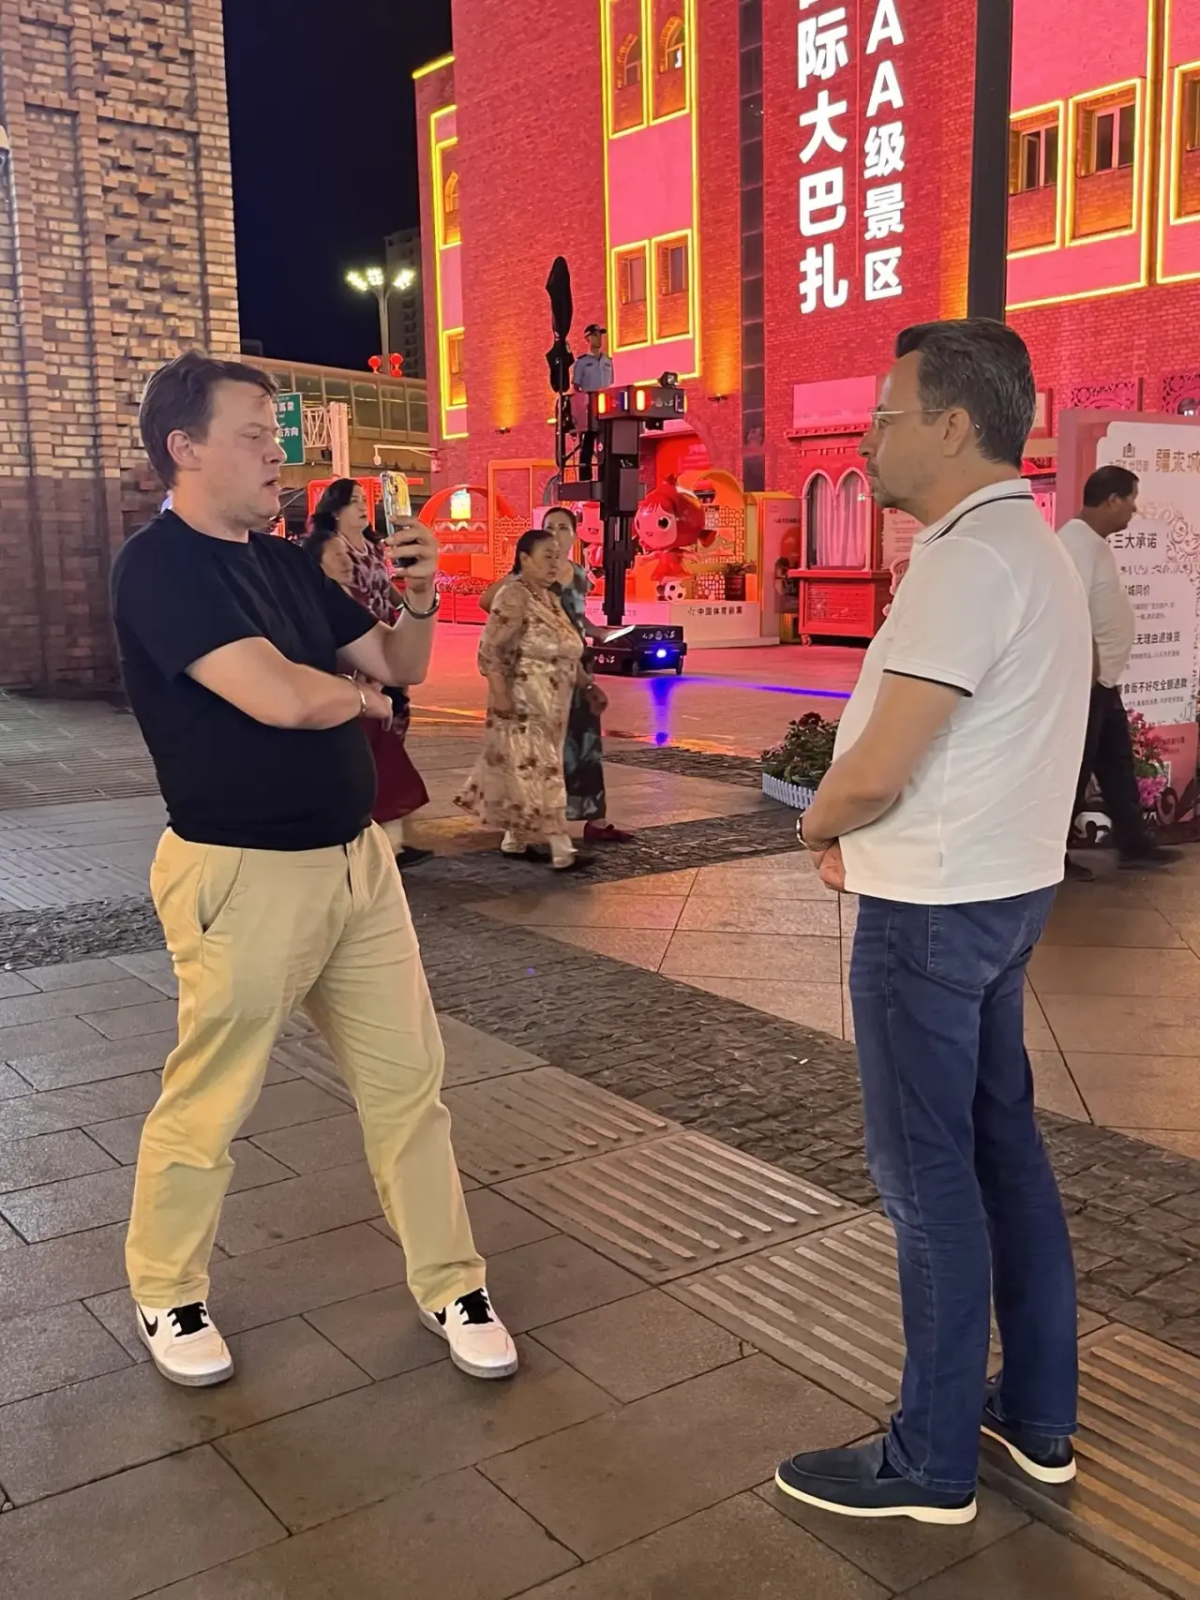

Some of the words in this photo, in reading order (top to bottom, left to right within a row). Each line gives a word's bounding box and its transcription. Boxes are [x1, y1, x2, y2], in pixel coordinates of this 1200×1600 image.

[797, 0, 849, 314] 际大巴扎
[863, 0, 905, 302] AA级景区
[1108, 532, 1157, 549] 三大承诺
[1124, 584, 1150, 596] 城同价
